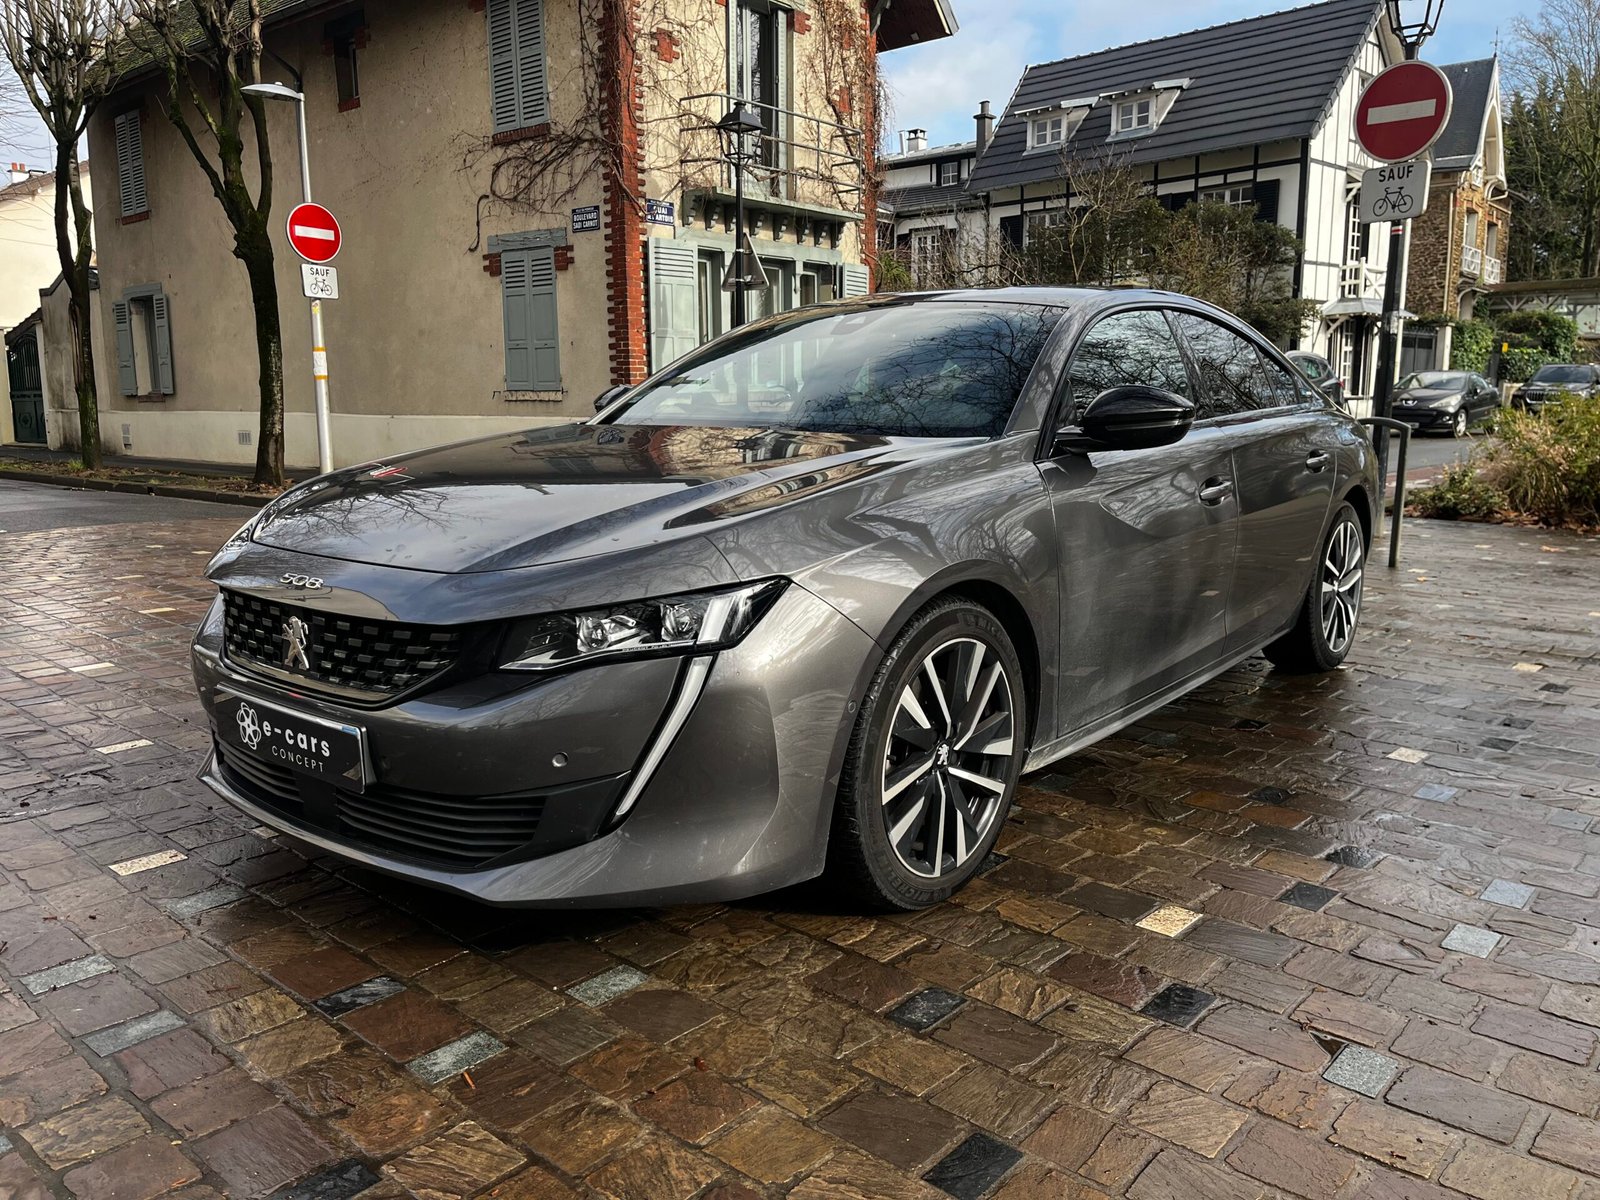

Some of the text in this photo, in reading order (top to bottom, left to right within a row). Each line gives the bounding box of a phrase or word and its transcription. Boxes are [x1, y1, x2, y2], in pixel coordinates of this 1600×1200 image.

[1378, 165, 1414, 182] SAUF
[574, 212, 597, 221] BOULEVARD
[583, 220, 598, 228] CARNOT
[309, 267, 330, 277] SAUF
[279, 572, 324, 589] 508
[262, 720, 331, 757] e-cars
[271, 745, 324, 773] CONCEPT
